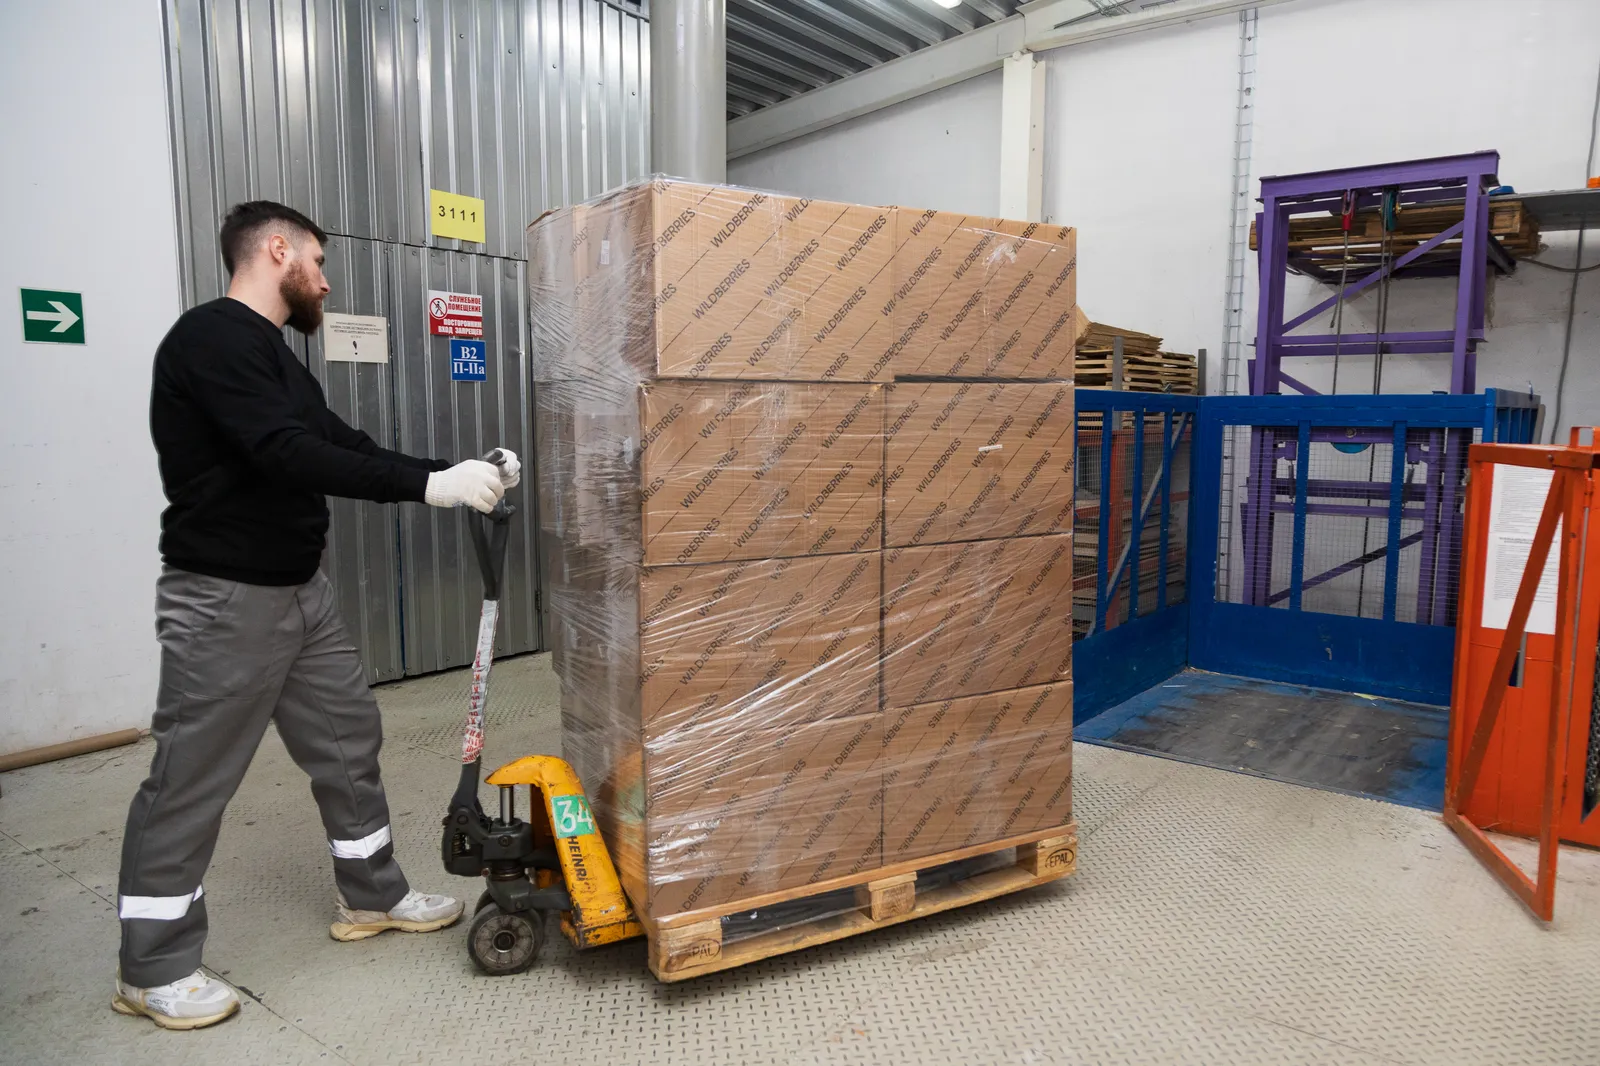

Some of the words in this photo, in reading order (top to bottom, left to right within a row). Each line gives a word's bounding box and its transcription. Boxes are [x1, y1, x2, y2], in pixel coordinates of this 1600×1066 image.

[764, 239, 820, 298] WILDBERRIES
[835, 214, 887, 272] WILDBERRIES
[448, 295, 481, 305] СЛУЖЕБНОЕ
[692, 259, 750, 320] WILDBERRIES
[898, 246, 942, 300] WILDBERRIES
[993, 270, 1034, 322] WILDBERRIES
[438, 325, 453, 335] ВХОД
[455, 327, 483, 336] ЗАПРЕЩЕН
[447, 303, 481, 313] ПОМЕЩЕНИЕ
[813, 286, 867, 344] WILDBERRIES
[940, 289, 983, 341] WILDBERRIES
[687, 332, 732, 378] DBERRIES
[746, 307, 802, 368] WILDBERRIES
[1031, 311, 1070, 361] WILDBERRIES
[1025, 388, 1066, 439] WILDBERRIES
[680, 447, 739, 509] WILDBERRIES
[802, 461, 854, 520] WILDBERRIES
[916, 437, 962, 493] WILDBERRIES
[1010, 450, 1052, 503] WILDBERRIES
[734, 487, 790, 548] WILDBERRIES
[957, 473, 1001, 528] WILDBERRIES
[818, 557, 870, 616] WILDBERRIES
[1026, 543, 1066, 596] WILDBERRIES
[821, 722, 872, 782] WILDBERRIES
[557, 800, 593, 833] 34
[1048, 851, 1071, 868] EPAL
